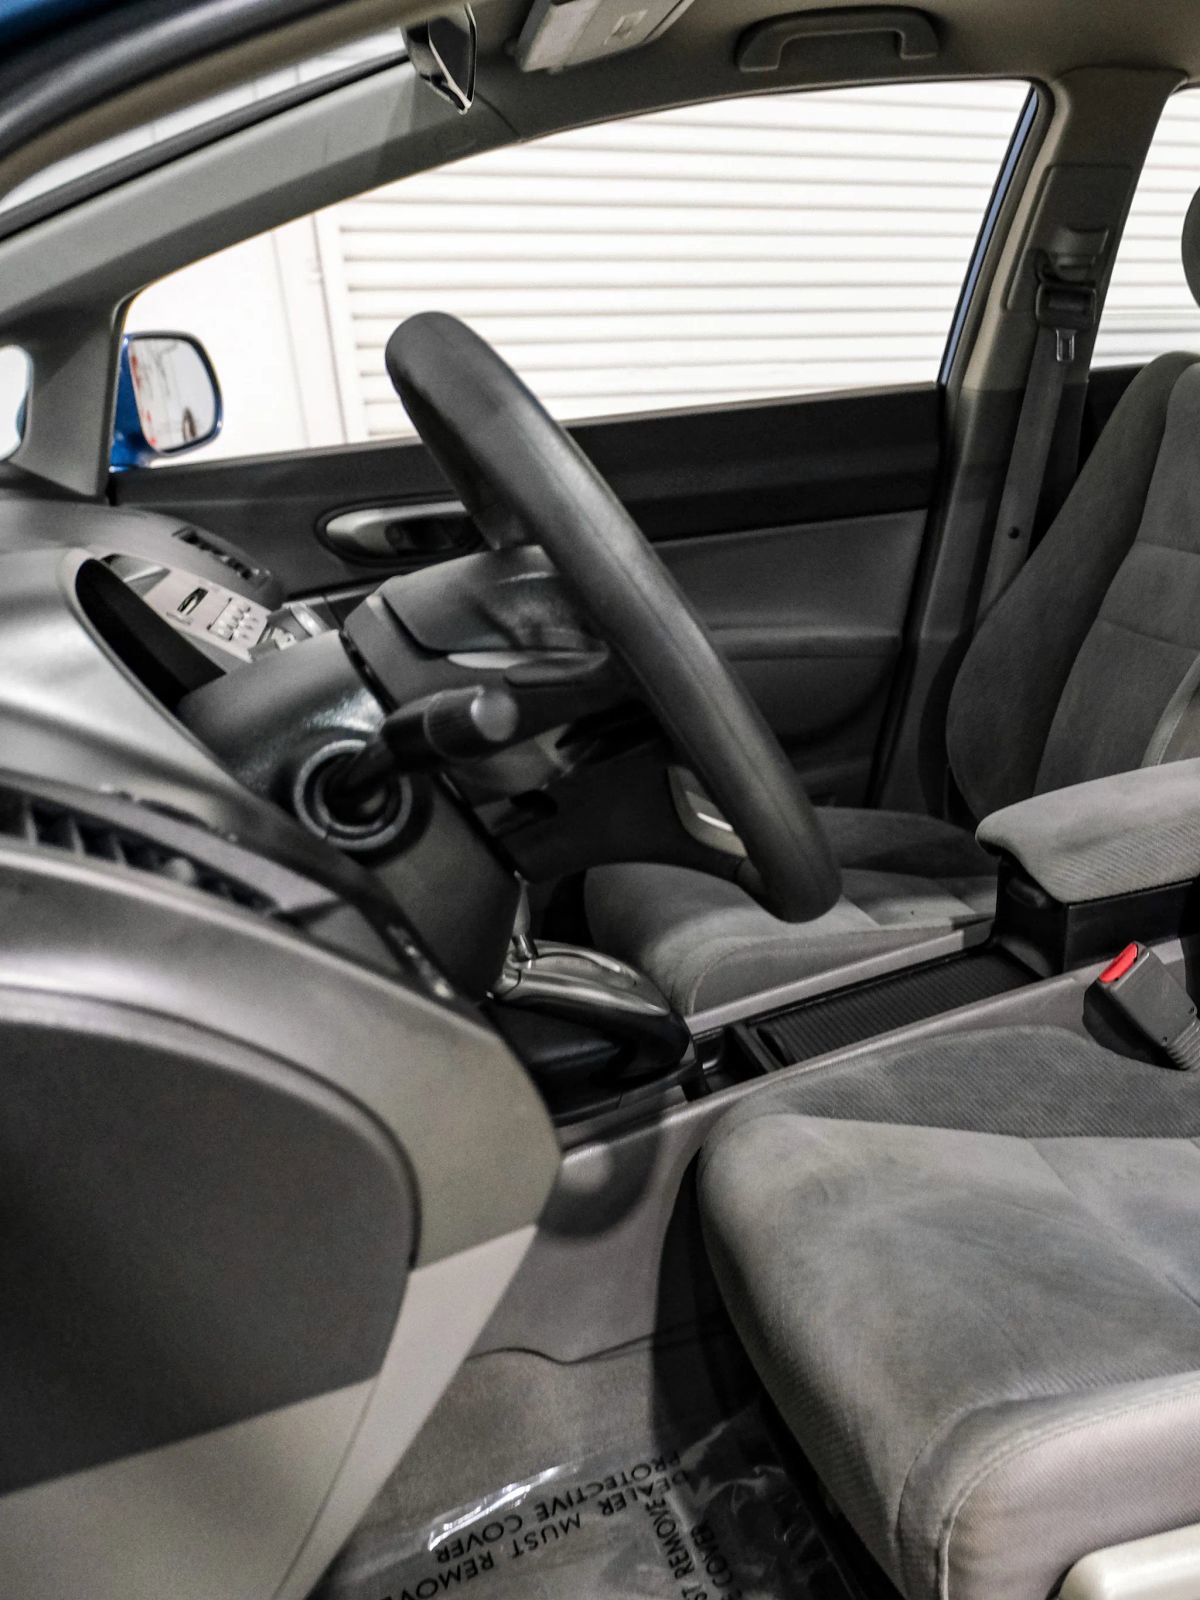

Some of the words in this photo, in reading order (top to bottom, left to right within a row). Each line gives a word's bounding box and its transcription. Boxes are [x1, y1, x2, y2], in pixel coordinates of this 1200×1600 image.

[533, 1450, 682, 1522] PROTECTIVE
[597, 1469, 691, 1517] DEALER
[434, 1513, 524, 1564] COVER
[511, 1511, 582, 1561] MUST
[645, 1497, 697, 1581] REMOVE
[690, 1520, 735, 1589] COVER
[379, 1549, 495, 1600] REMOV
